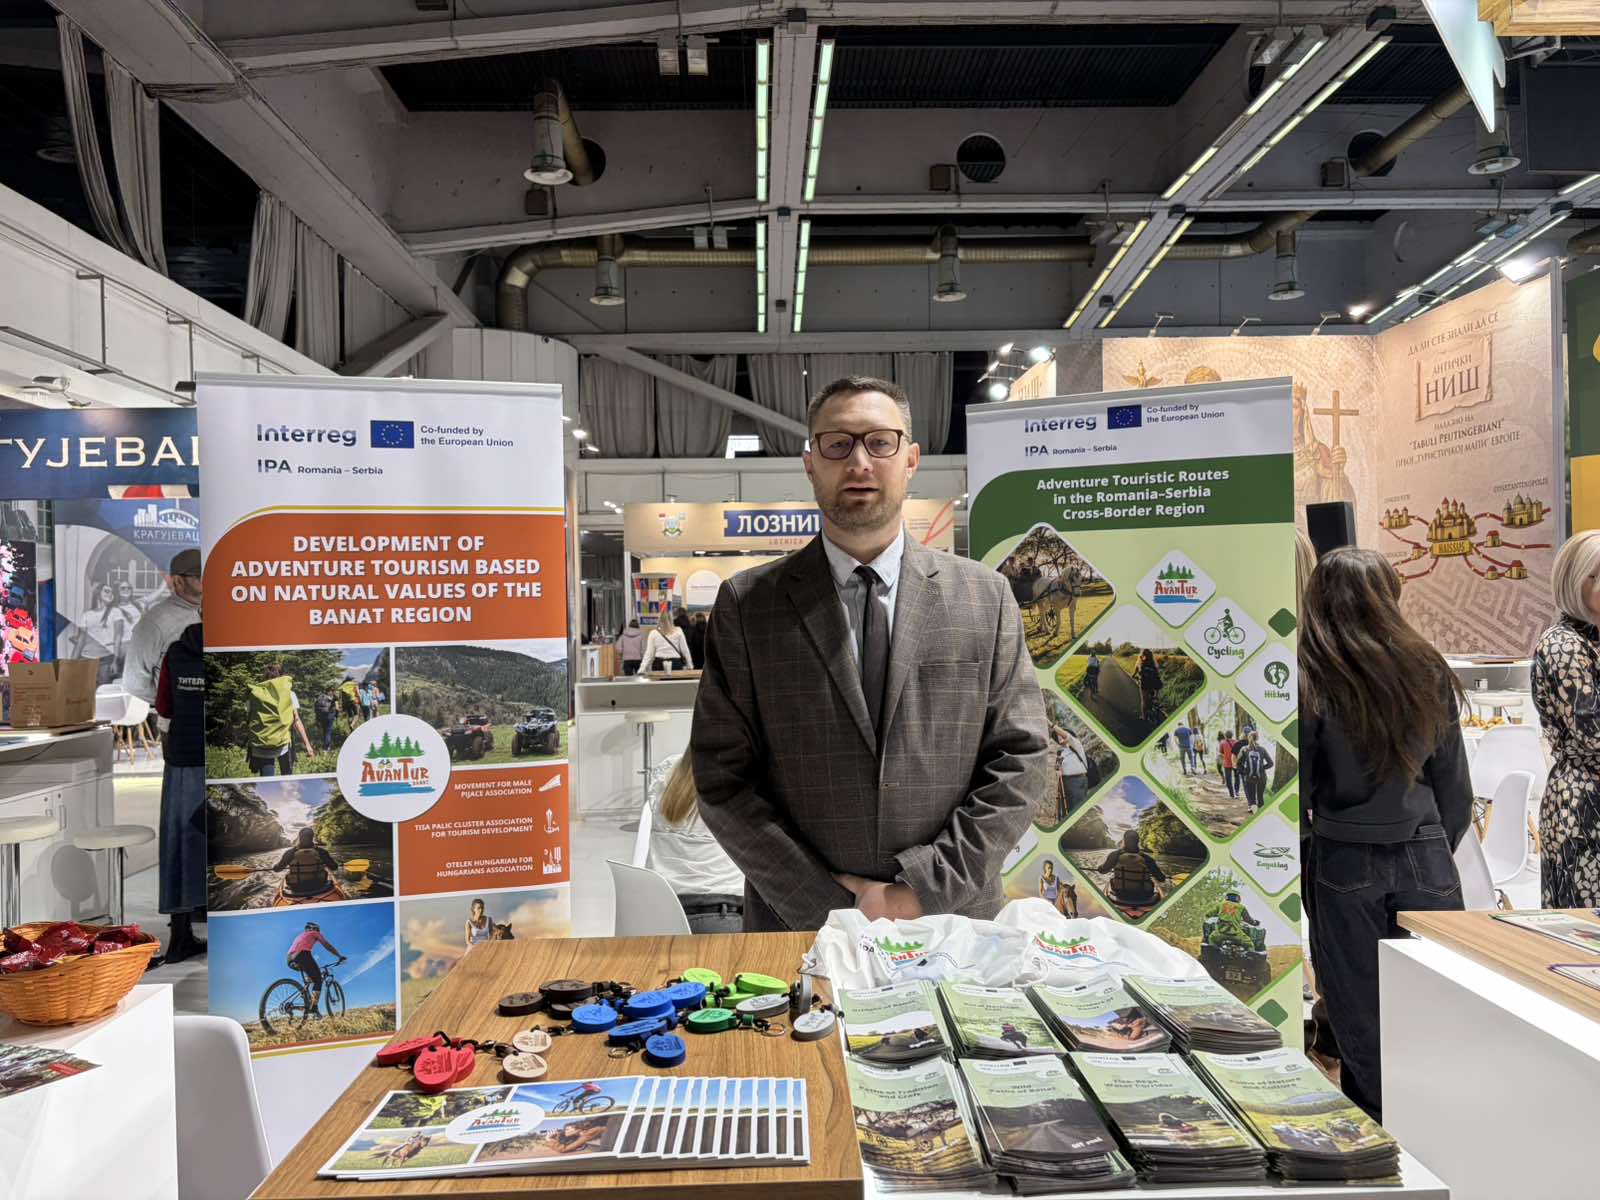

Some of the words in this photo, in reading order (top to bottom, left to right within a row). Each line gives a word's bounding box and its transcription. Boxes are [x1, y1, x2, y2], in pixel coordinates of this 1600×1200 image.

[1431, 333, 1445, 345] СТЕ
[1488, 312, 1498, 323] СЕ
[1426, 366, 1480, 405] НИШ
[1025, 416, 1096, 433] Interreg
[1147, 404, 1187, 414] Co-funded
[1189, 404, 1199, 412] by
[1147, 416, 1159, 424] the
[1161, 412, 1199, 423] European
[1202, 410, 1225, 419] Union
[256, 424, 357, 446] Interreg
[420, 425, 470, 435] Co-funded
[472, 426, 484, 436] by
[420, 436, 436, 446] the
[439, 436, 484, 448] European
[486, 437, 513, 446] Union
[1025, 445, 1049, 457] IPA
[1053, 447, 1085, 455] Romania
[1093, 444, 1117, 453] Serbia
[257, 459, 292, 473] IPA
[298, 466, 342, 475] Romania
[352, 466, 383, 475] Serbia
[1037, 475, 1109, 491] Adventure
[1113, 472, 1175, 486] Touristic
[1179, 469, 1230, 482] Routes
[1054, 494, 1066, 504] in
[1070, 491, 1092, 504] the
[1096, 486, 1211, 502] Romania–Serbia
[1063, 505, 1151, 520] Cross-Border
[1155, 503, 1205, 518] Region
[293, 536, 453, 553] DEVELOPMENT
[457, 535, 484, 552] OF
[231, 560, 365, 578] ADVENTURE
[370, 560, 469, 576] TOURISM
[475, 559, 540, 575] BASED
[231, 585, 266, 602] ON
[274, 584, 379, 602] NATURAL
[384, 583, 465, 600] VALUES
[471, 583, 499, 599] OF
[503, 582, 542, 598] THE
[309, 608, 384, 626] BANAT
[390, 607, 472, 624] REGION
[1207, 645, 1245, 659] Cycling
[1264, 690, 1290, 701] Hiking
[455, 782, 495, 790] MOVEMENT
[485, 788, 532, 797] ASSOCIATION
[454, 820, 484, 828] CLUSTER
[486, 817, 533, 826] ASSOCIATION
[448, 828, 480, 837] TOURISM
[482, 825, 533, 835] DEVELOPMENT
[474, 858, 517, 866] HUNGARIAN
[437, 869, 485, 877] HUNGARIANS
[486, 865, 533, 874] ASSOCIATION
